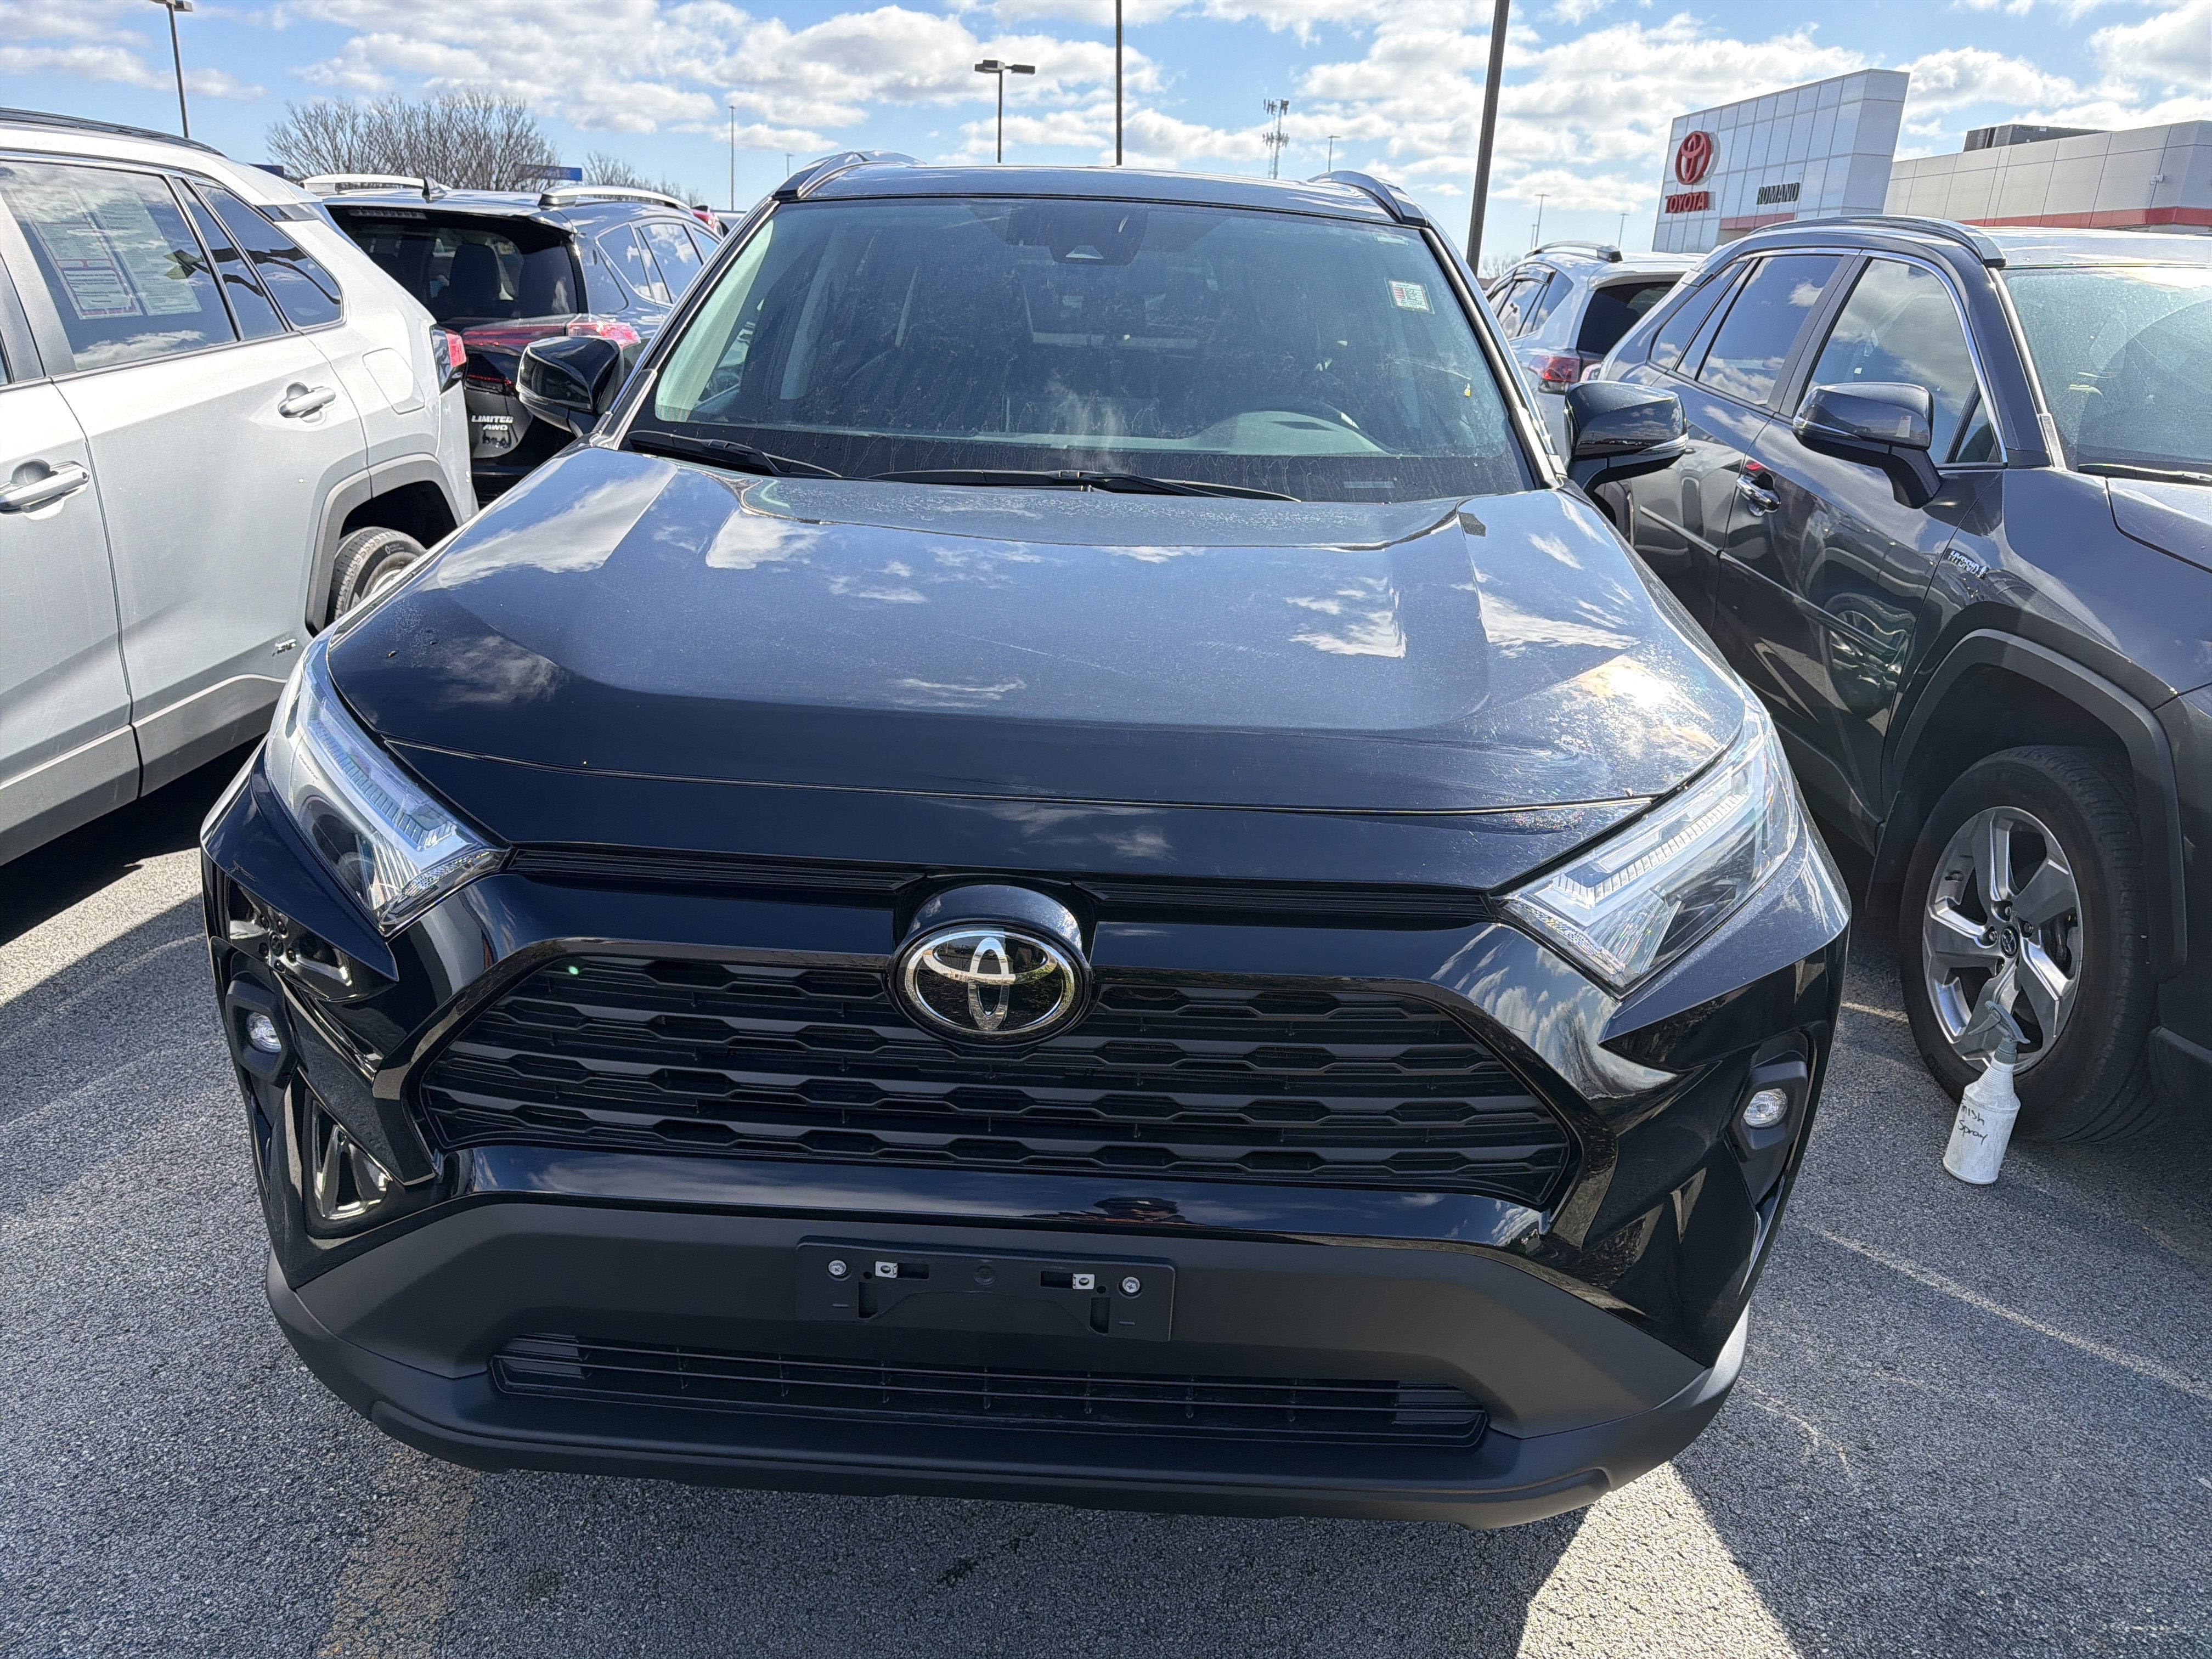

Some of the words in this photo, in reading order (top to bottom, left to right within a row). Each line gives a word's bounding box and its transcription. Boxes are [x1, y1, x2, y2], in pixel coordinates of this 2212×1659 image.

[1664, 191, 1708, 213] TOYOTA
[1757, 183, 1800, 205] ROMANO
[471, 415, 514, 424] LIMITED
[1948, 550, 1980, 575] HYBRID
[1957, 1119, 1989, 1146] Spray
